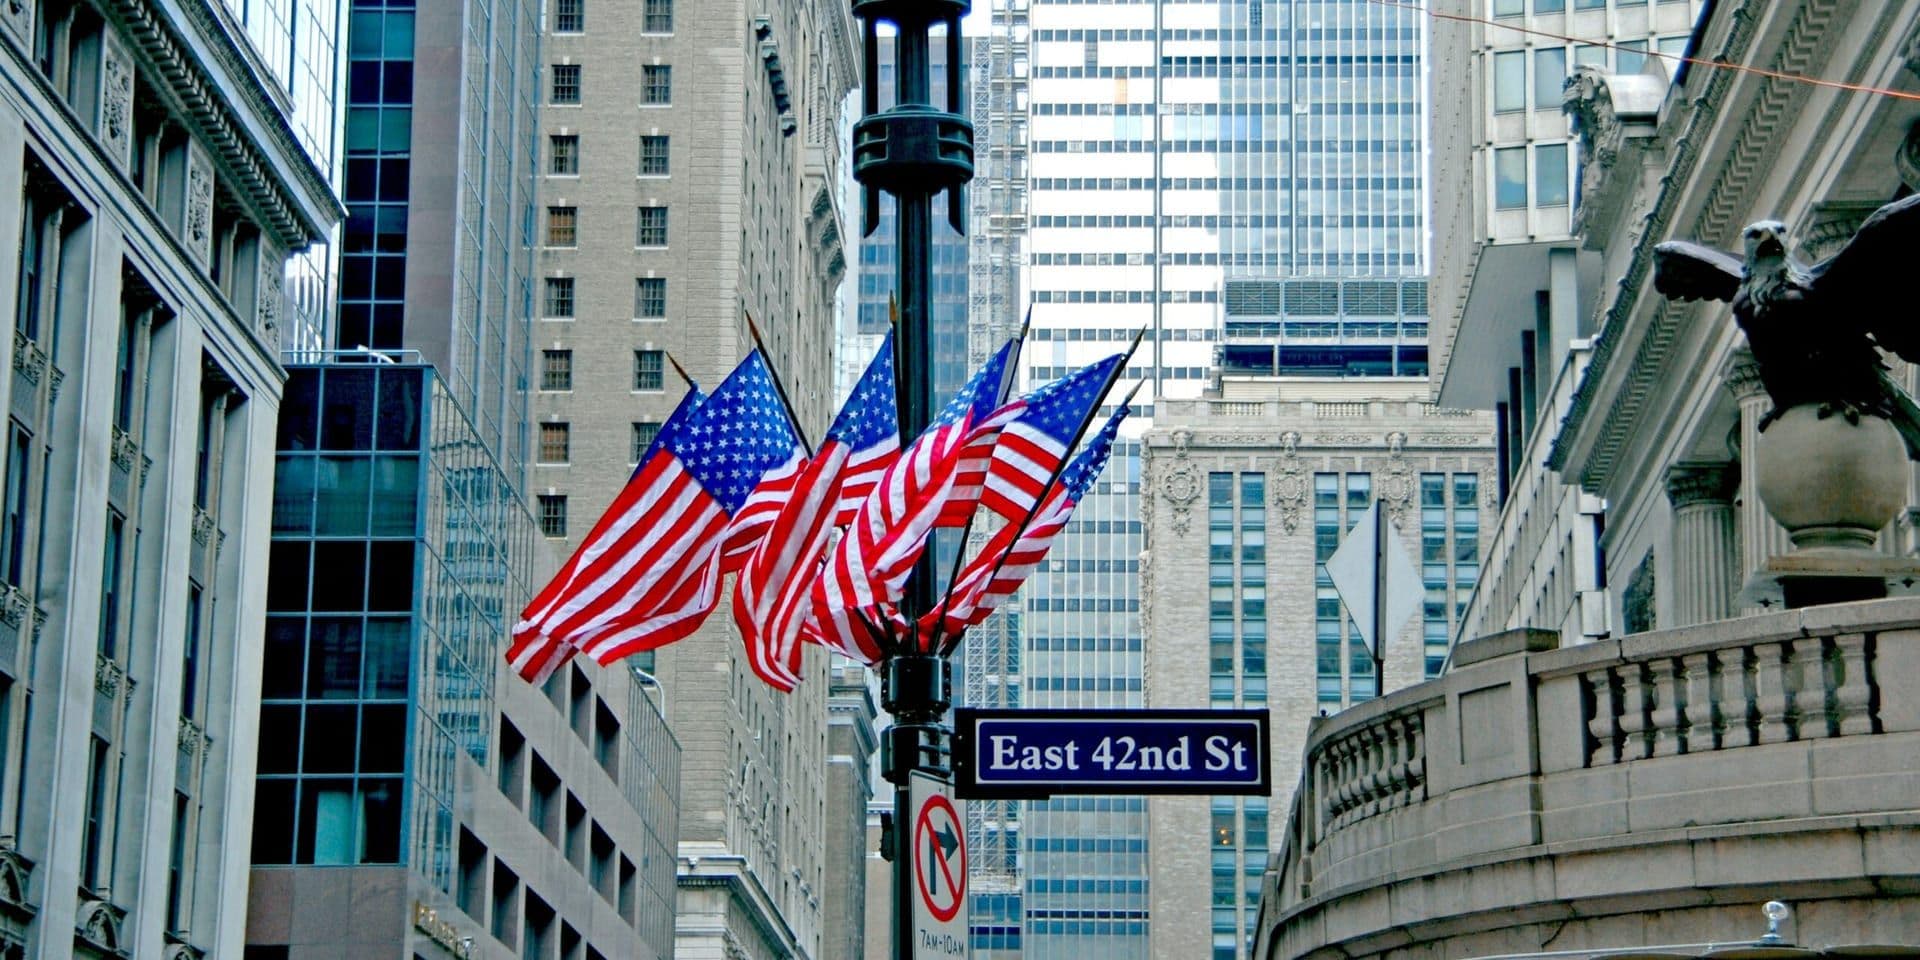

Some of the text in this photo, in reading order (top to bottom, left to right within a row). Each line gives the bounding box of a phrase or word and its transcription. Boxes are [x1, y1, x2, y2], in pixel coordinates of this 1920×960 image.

[989, 735, 1247, 771] East 42nd St
